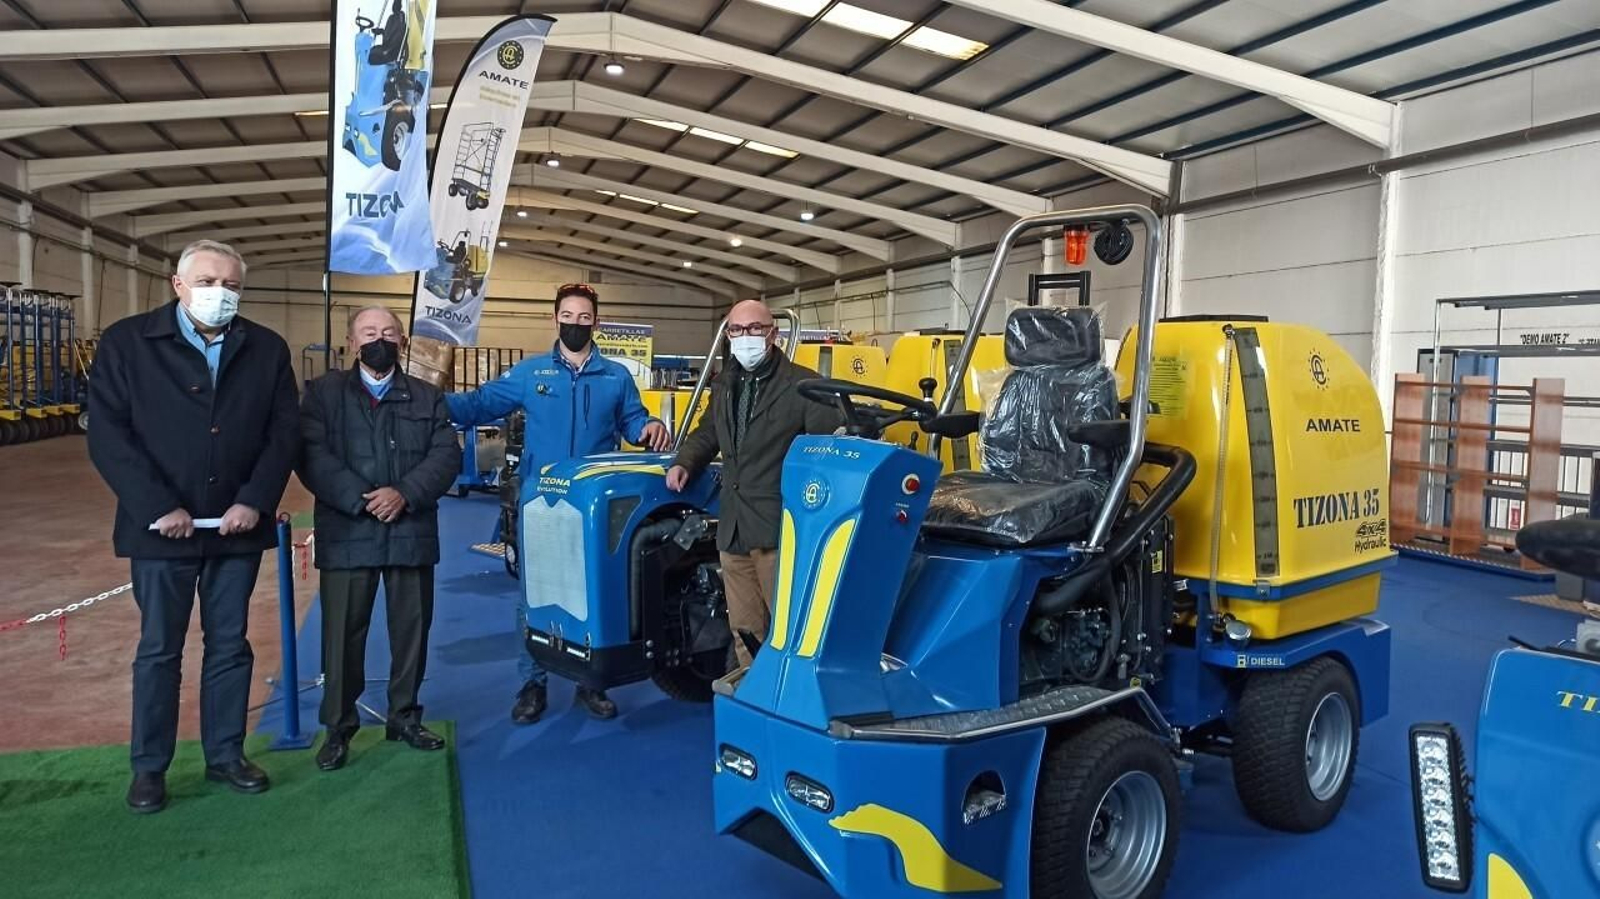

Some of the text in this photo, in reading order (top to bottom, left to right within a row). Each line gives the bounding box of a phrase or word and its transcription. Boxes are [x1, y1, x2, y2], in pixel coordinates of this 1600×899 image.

[479, 70, 530, 90] AMATE
[425, 305, 472, 325] TIZONA
[596, 334, 648, 343] AMATE
[1520, 334, 1540, 345] "DEMO
[1541, 333, 1561, 345] AMATE
[600, 347, 647, 357] ONA 35
[1305, 418, 1361, 432] AMATE
[803, 446, 860, 459] TIZONA 35
[539, 477, 571, 487] TIZONA
[1293, 488, 1380, 528] TIZONA 35
[1354, 537, 1387, 554] Hydraulic
[1250, 656, 1286, 666] DIESEL
[1556, 690, 1600, 714] TI
